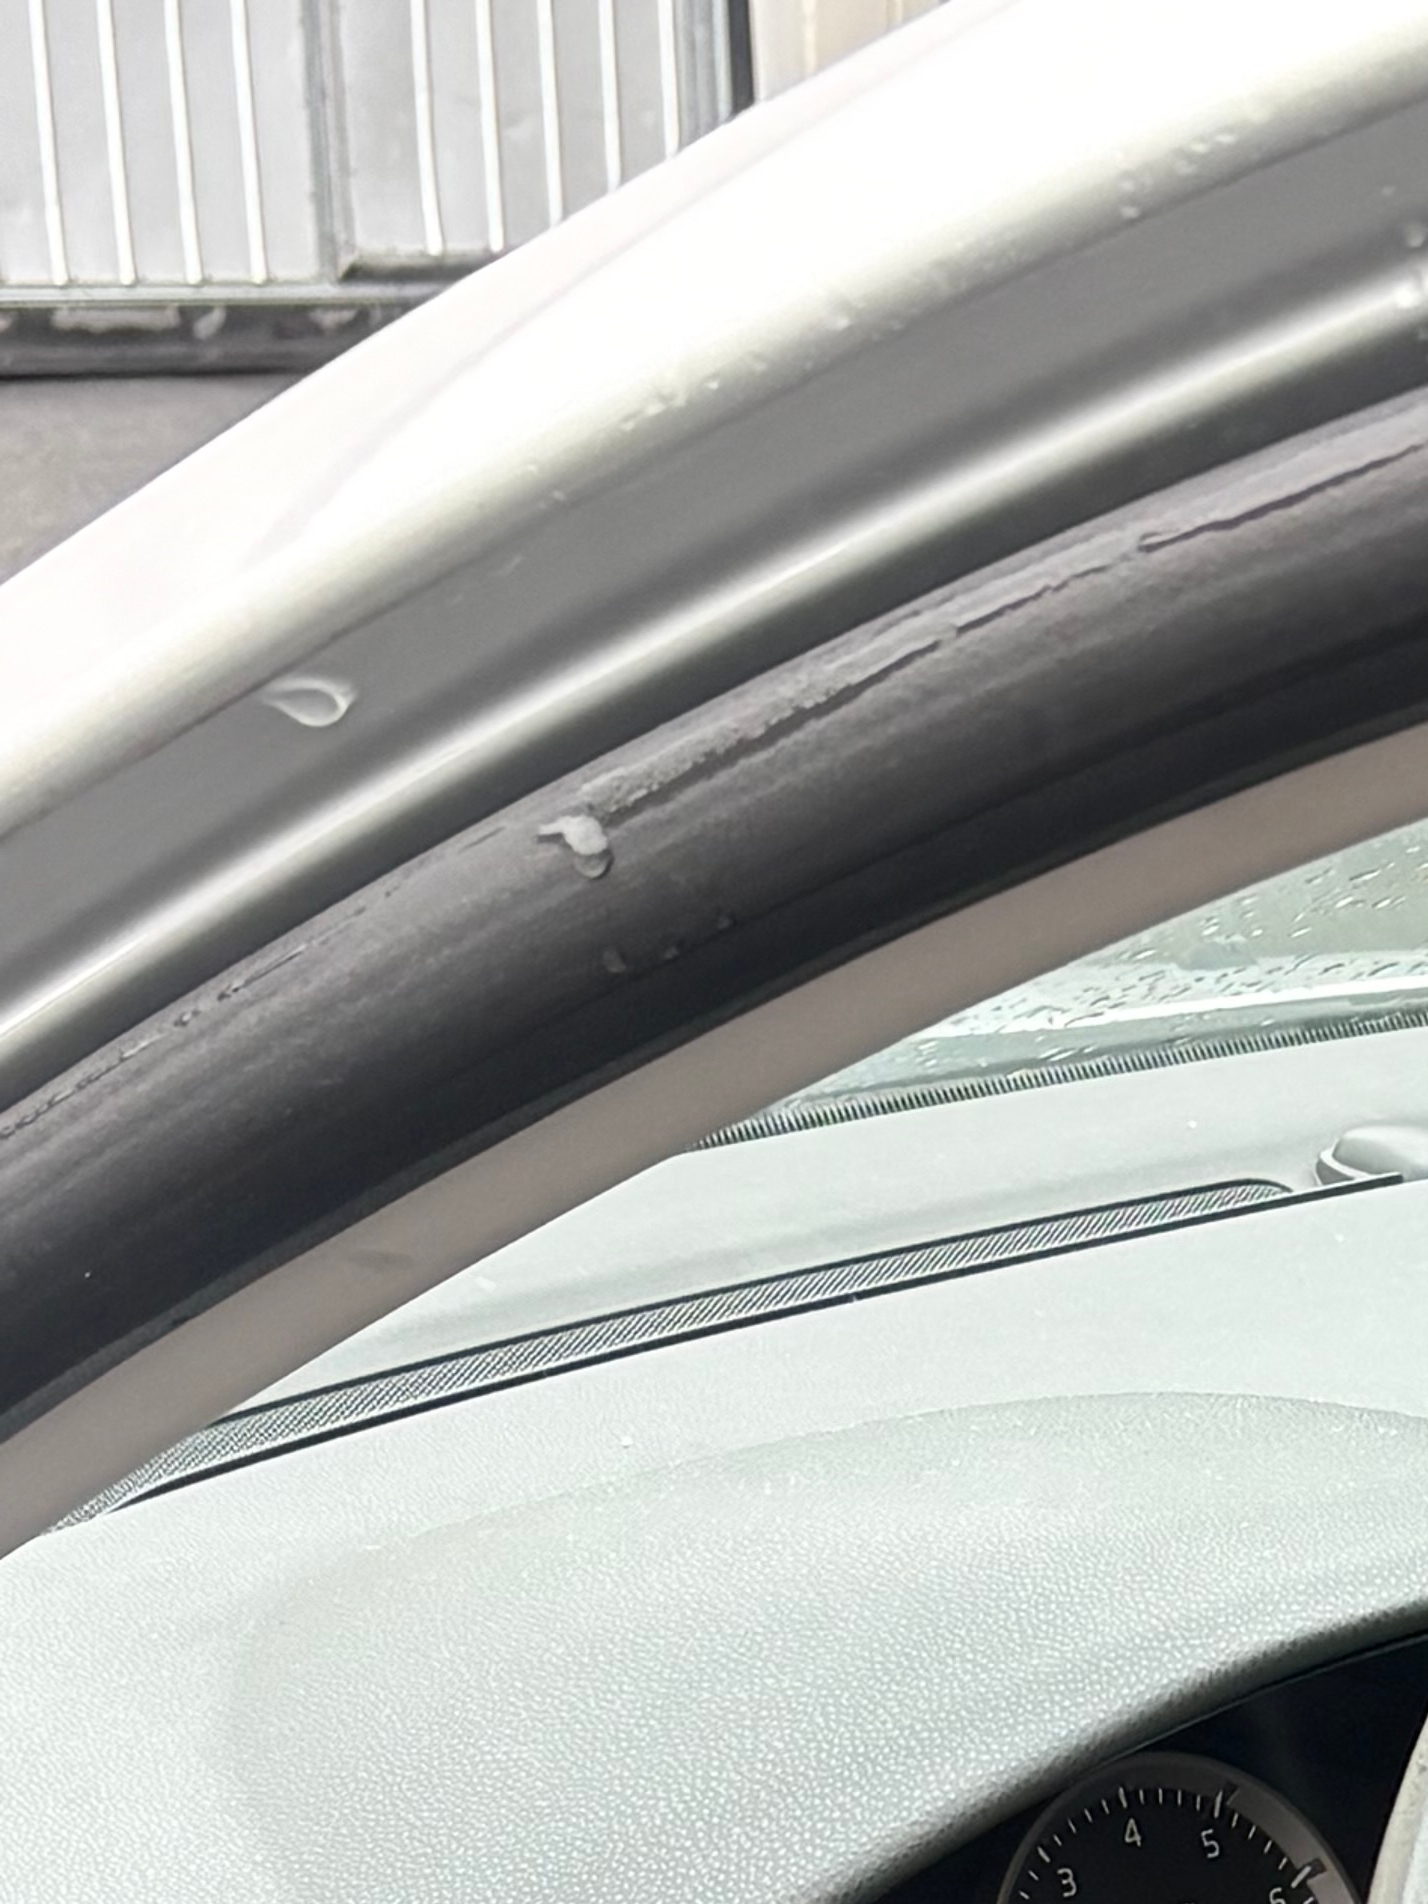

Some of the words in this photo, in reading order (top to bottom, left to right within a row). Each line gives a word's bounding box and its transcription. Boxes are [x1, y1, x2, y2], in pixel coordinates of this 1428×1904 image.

[1124, 1818, 1143, 1848] 4
[1201, 1829, 1220, 1859] 5
[1057, 1868, 1078, 1898] 3
